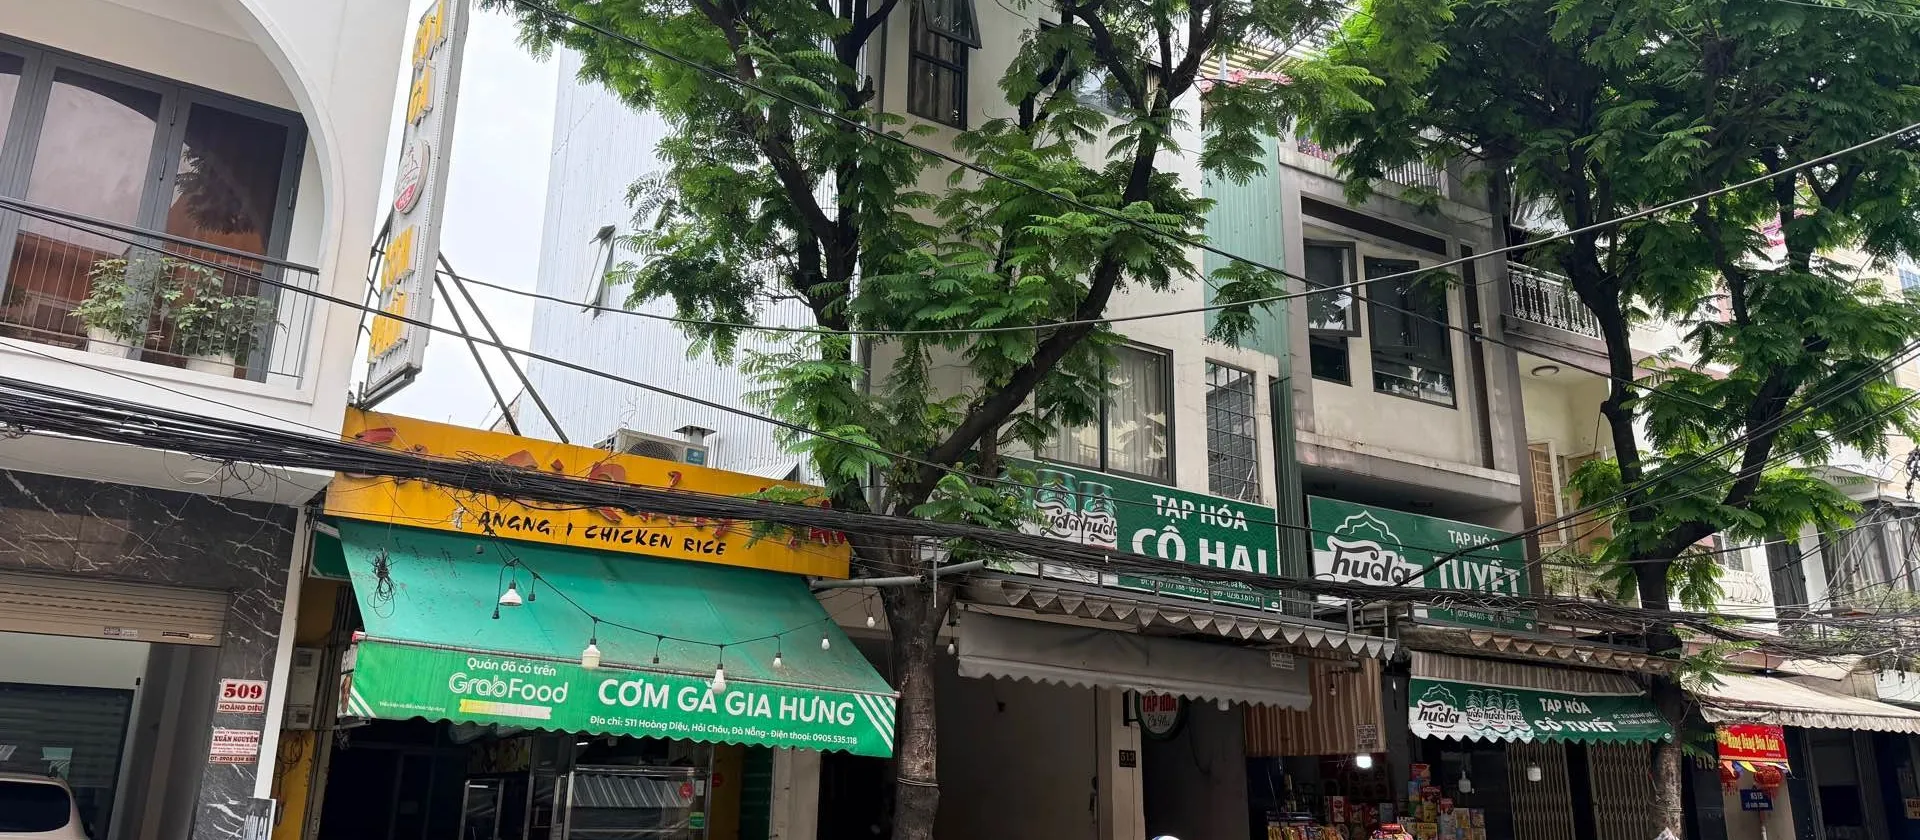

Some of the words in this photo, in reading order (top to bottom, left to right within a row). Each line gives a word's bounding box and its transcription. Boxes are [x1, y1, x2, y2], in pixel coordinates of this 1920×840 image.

[1152, 494, 1195, 523] TẠP
[1200, 503, 1248, 532] HÓA
[585, 525, 673, 549] CHICKEN
[683, 537, 727, 556] RICE
[1132, 525, 1186, 562] CÔ
[1199, 538, 1268, 575] HAI
[1448, 530, 1471, 550] TẠP
[1331, 543, 1411, 584] huda
[467, 657, 498, 671] Quán
[501, 660, 516, 672] đã
[518, 663, 531, 674] có
[534, 665, 556, 676] trên
[224, 683, 263, 699] 509
[448, 672, 569, 703] GrabFood
[598, 679, 670, 709] CƠM
[677, 679, 717, 713] GÀ
[725, 691, 772, 718] GIA
[779, 696, 856, 725] HƯNG
[1418, 703, 1460, 723] huda
[1539, 698, 1562, 715] TẠP
[1563, 698, 1592, 714] HÓA
[590, 715, 605, 726] Địa
[624, 718, 637, 727] 511
[639, 719, 667, 731] Hoàng
[669, 721, 690, 732] Diệu,
[692, 723, 706, 732] Hải
[707, 724, 730, 734] Châu,
[732, 726, 743, 735] Đà
[745, 726, 765, 738] Nẵng
[770, 730, 788, 739] Điện
[789, 731, 811, 741] thoại:
[812, 733, 857, 745] 0905.535.118
[1534, 717, 1562, 731] CÔ
[1560, 717, 1618, 732] TUYẾT
